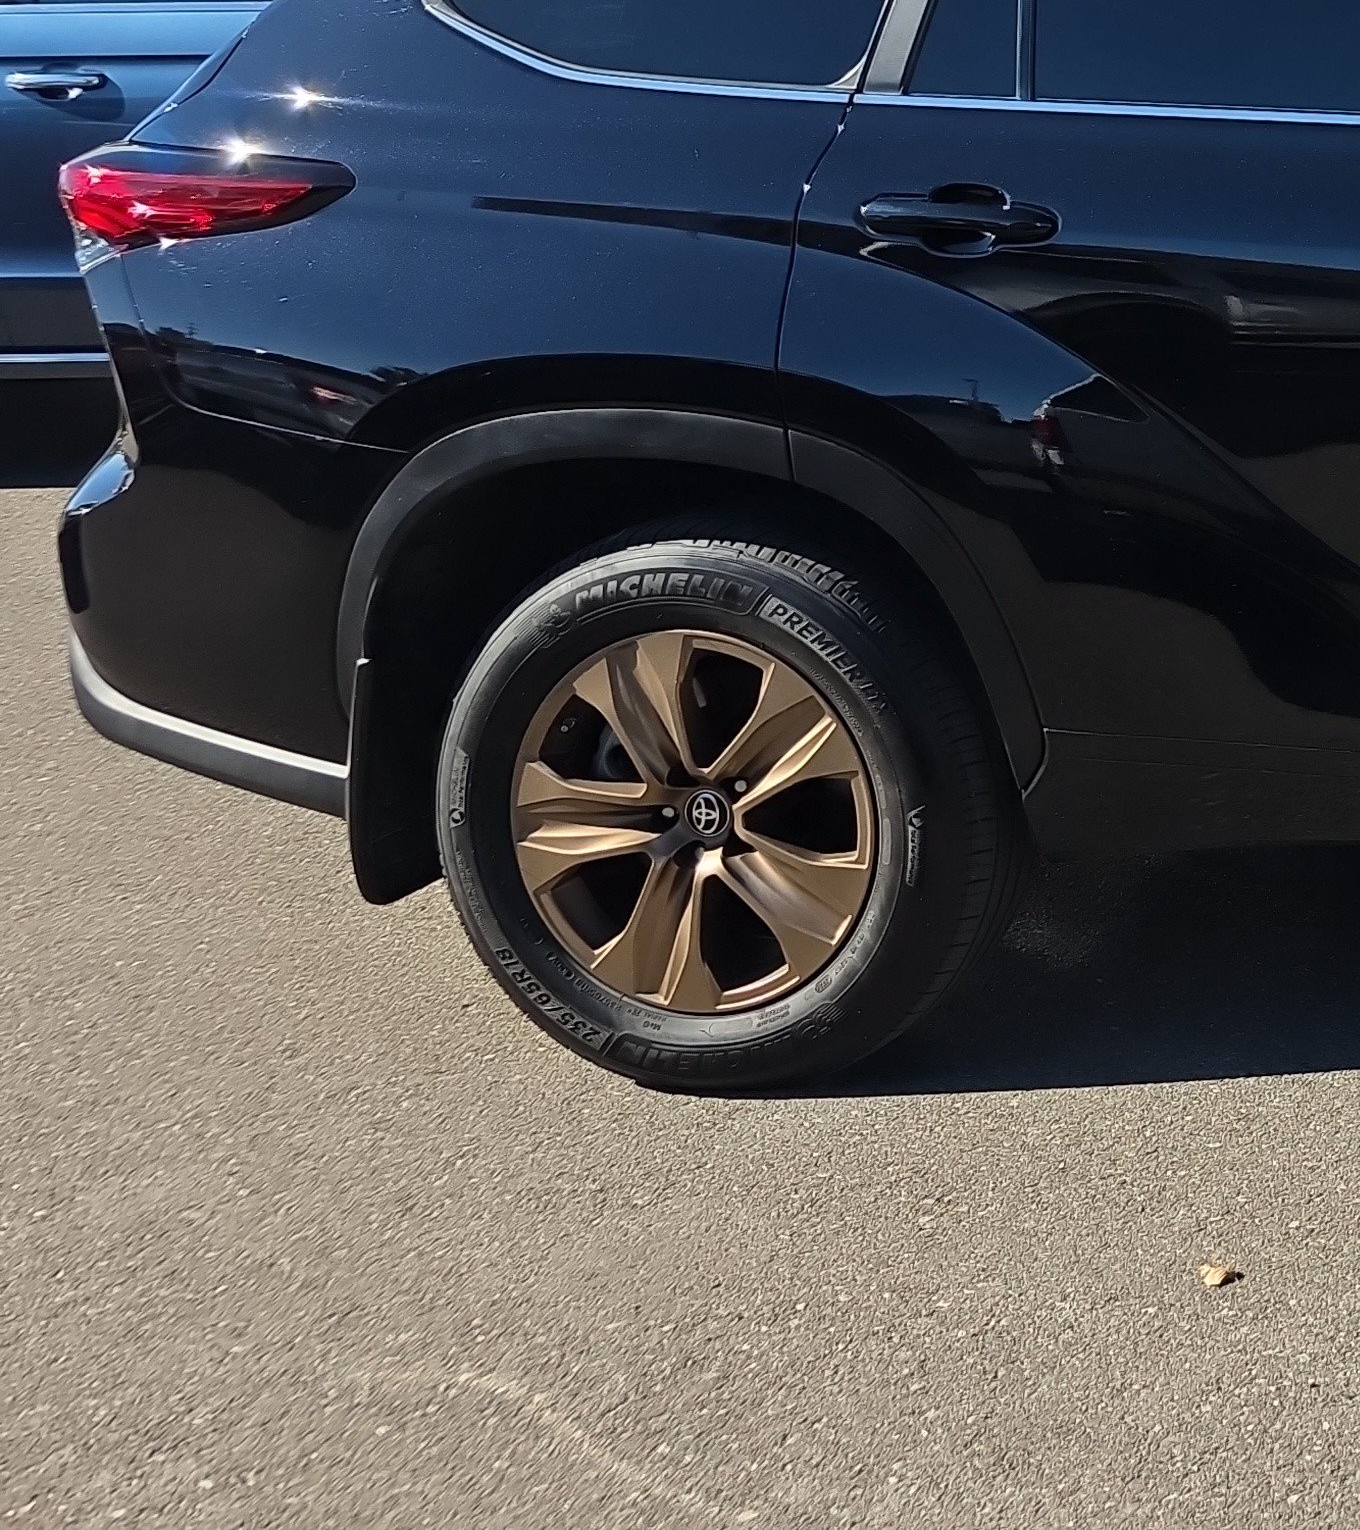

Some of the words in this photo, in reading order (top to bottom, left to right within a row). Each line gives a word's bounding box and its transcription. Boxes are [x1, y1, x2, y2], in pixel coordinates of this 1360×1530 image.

[575, 571, 754, 610] MICHELIN
[767, 601, 860, 684] PREMIER
[495, 948, 602, 1044] 235/65R18
